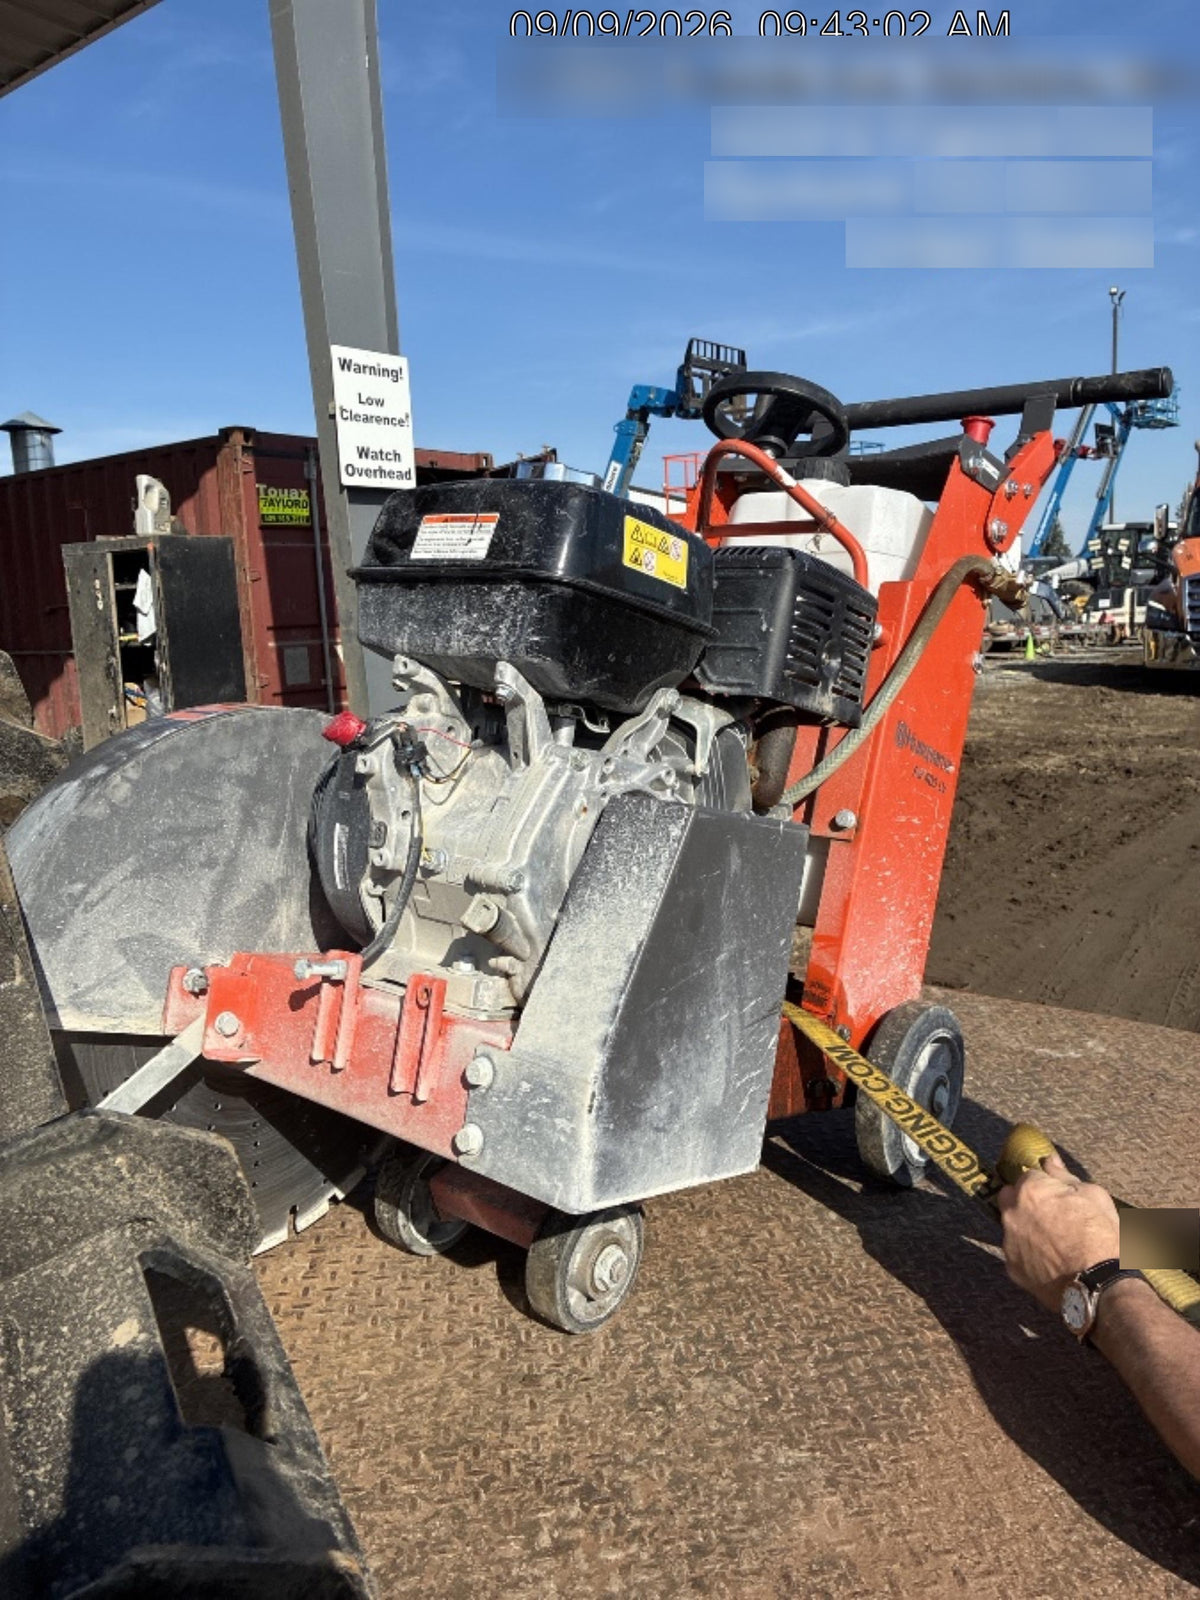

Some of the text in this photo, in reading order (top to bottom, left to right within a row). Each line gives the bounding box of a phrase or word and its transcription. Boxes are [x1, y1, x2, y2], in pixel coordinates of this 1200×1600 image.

[337, 356, 403, 383] Warning!
[358, 392, 385, 407] Low
[356, 445, 402, 463] Watch
[344, 463, 412, 481] Overhead
[824, 1044, 983, 1191] IGGING.COM
